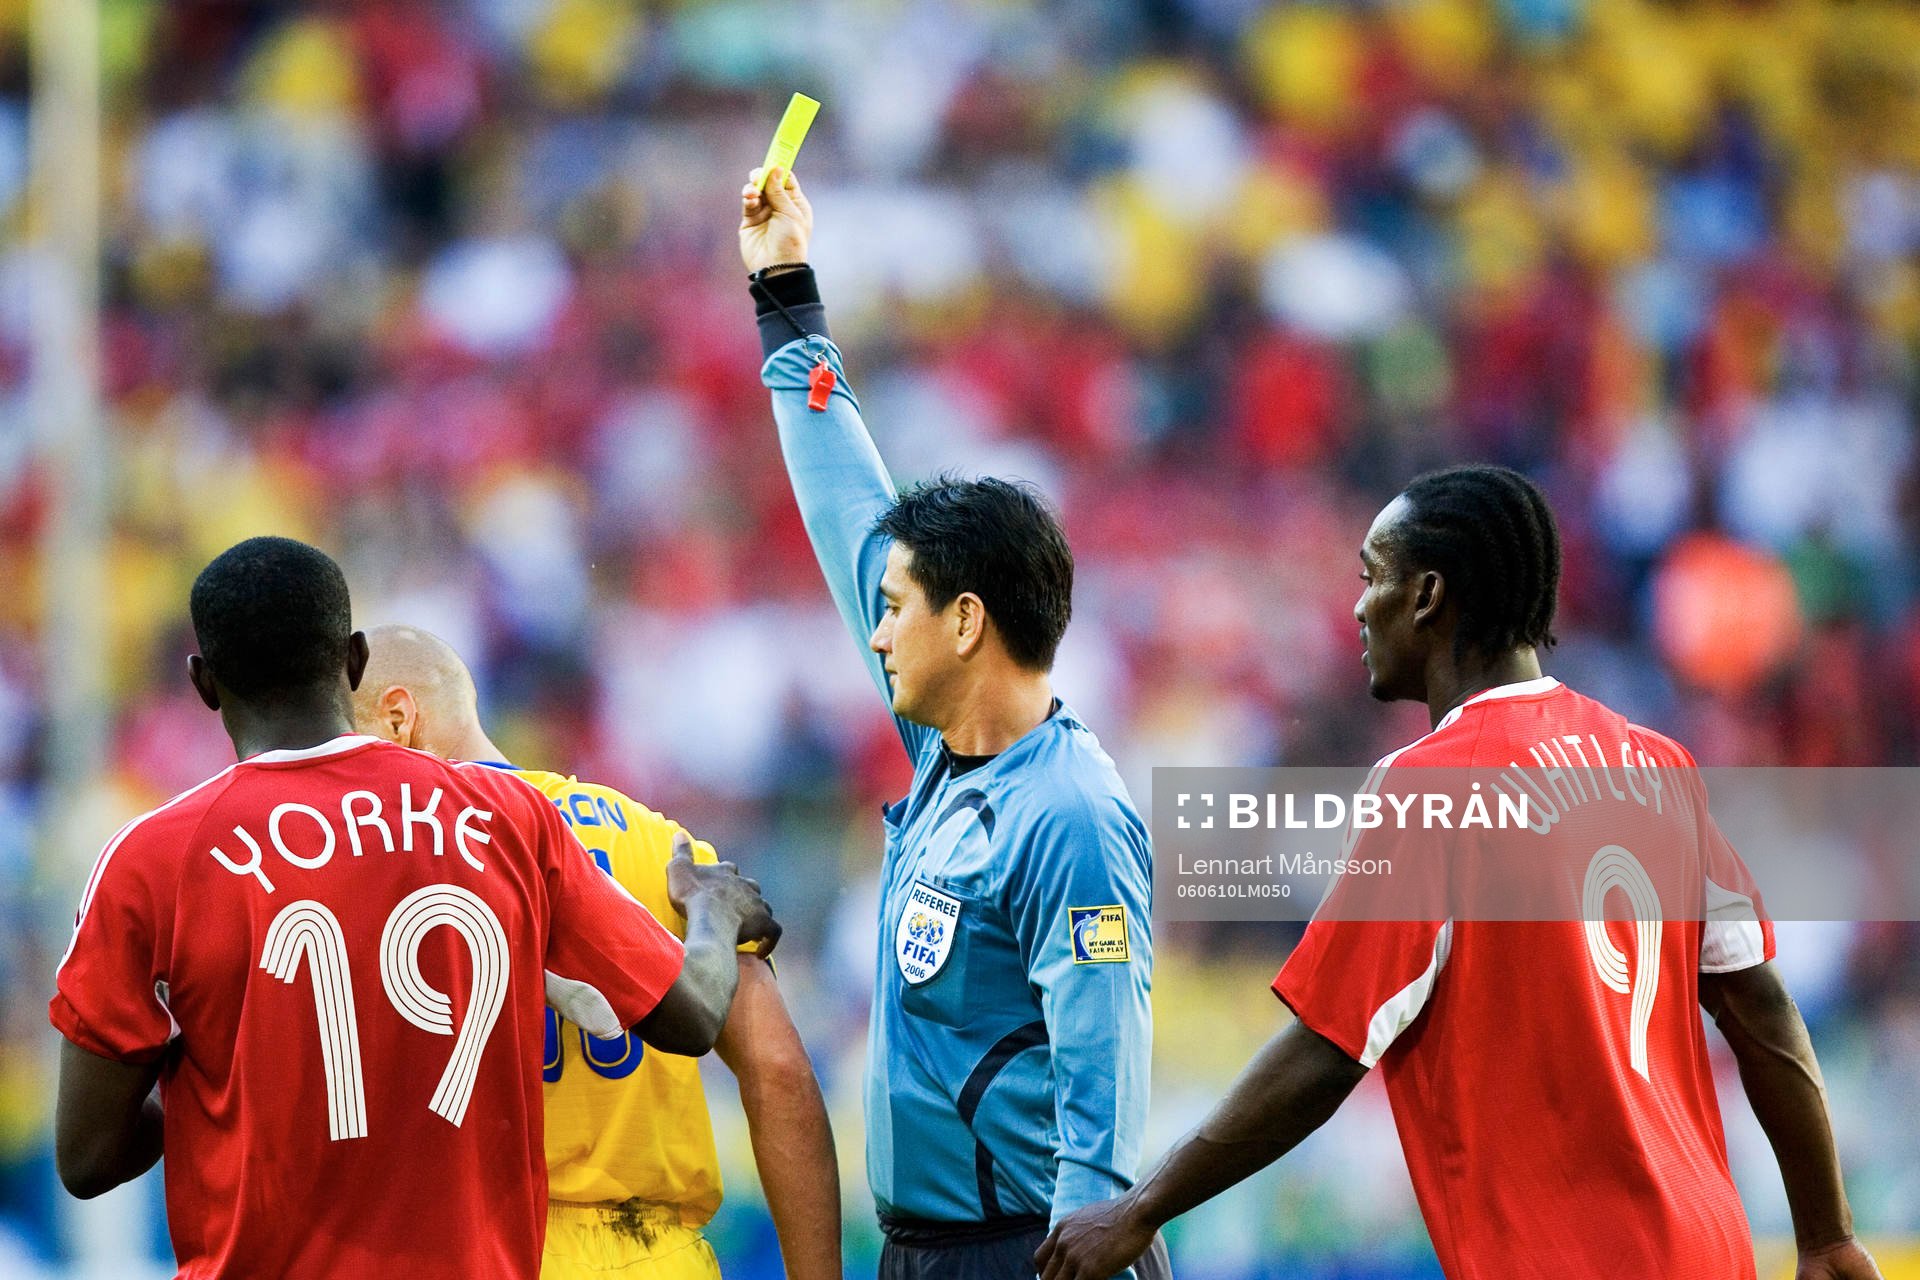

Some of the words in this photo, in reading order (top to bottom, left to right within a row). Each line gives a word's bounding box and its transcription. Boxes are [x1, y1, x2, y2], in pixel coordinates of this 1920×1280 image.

[1490, 734, 1662, 835] WHITLEY
[209, 783, 493, 894] YORKE
[912, 888, 957, 917] REFEREE
[1101, 914, 1121, 922] FIFA
[903, 940, 936, 967] FIFA
[904, 962, 926, 978] 2006
[1583, 844, 1663, 1084] 9
[259, 883, 510, 1141] 19
